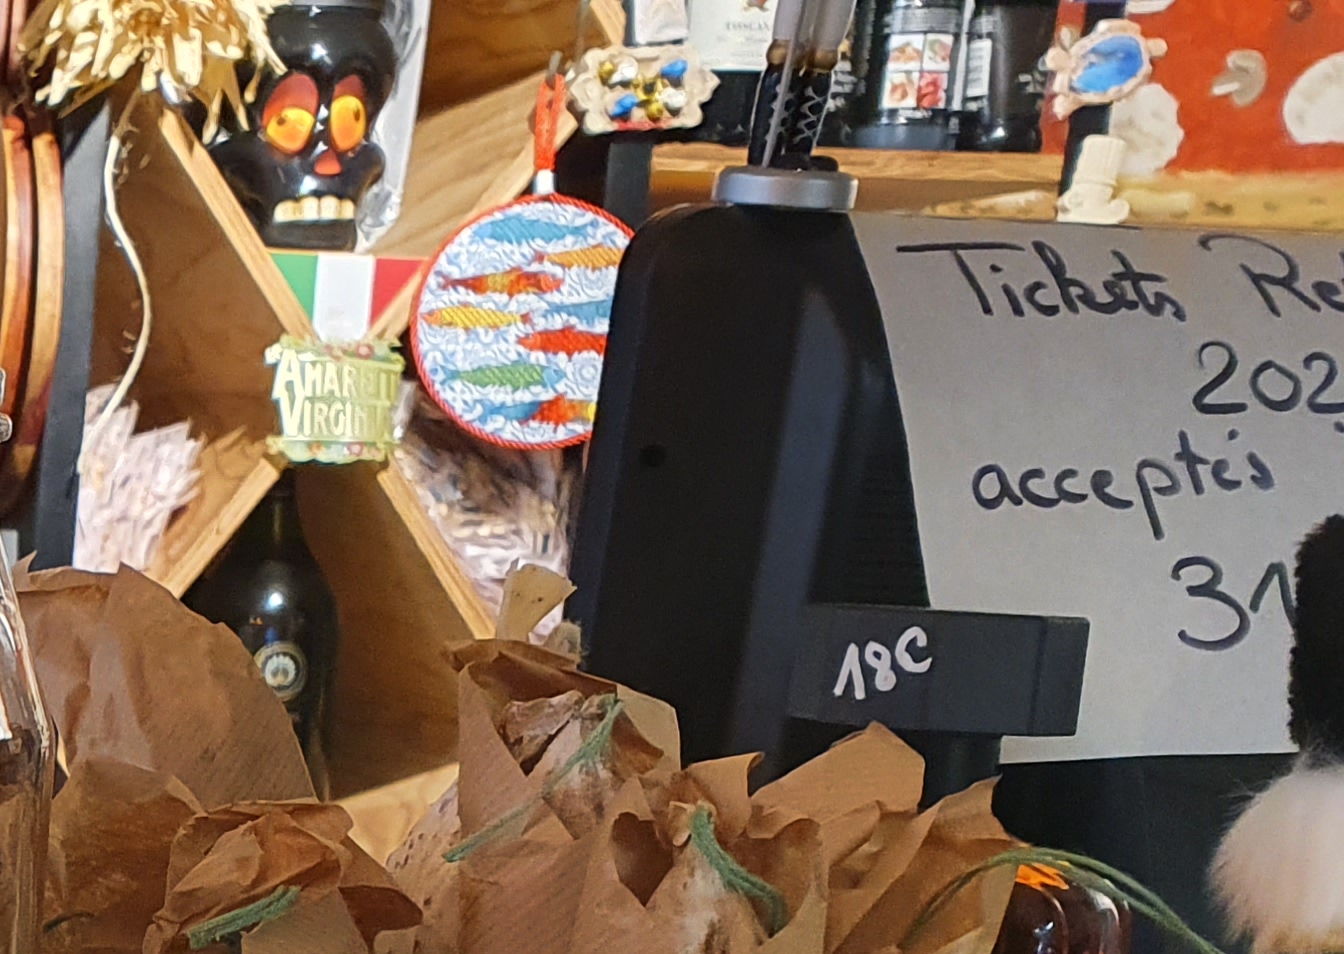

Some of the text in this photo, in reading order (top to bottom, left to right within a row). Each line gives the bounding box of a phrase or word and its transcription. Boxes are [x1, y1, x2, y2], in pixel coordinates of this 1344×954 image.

[896, 233, 1344, 322] Tickets Re
[1192, 340, 1344, 415] 202
[971, 428, 1276, 541] acceptés
